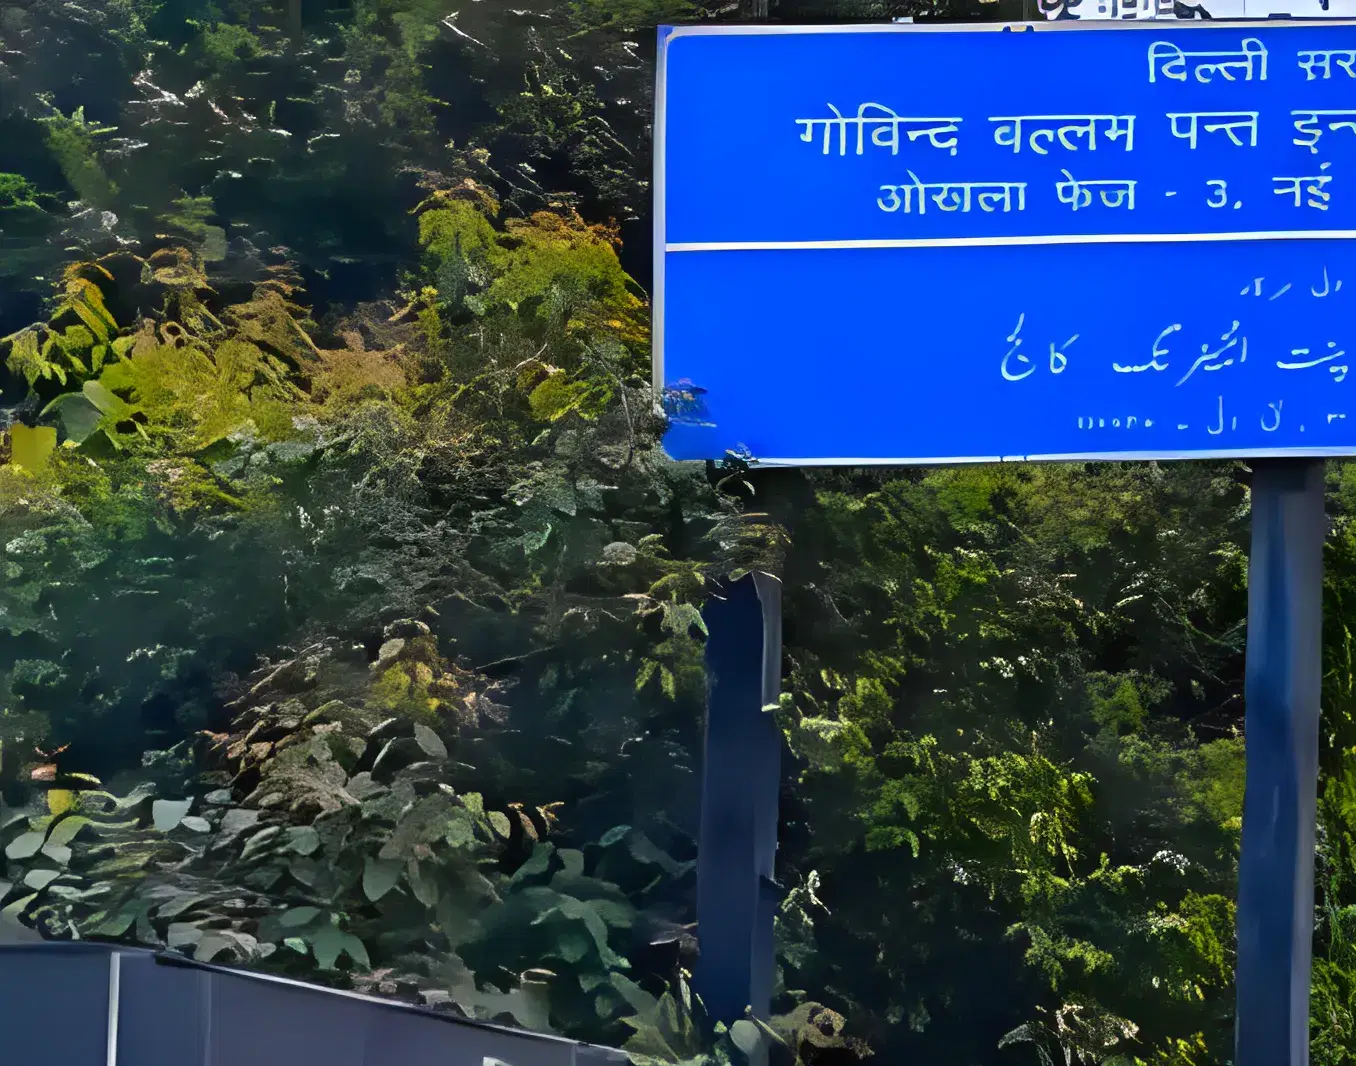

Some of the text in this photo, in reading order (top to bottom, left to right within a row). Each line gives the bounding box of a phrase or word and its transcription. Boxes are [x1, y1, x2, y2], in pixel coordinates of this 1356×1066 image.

[794, 102, 963, 156] गोविन्द
[1165, 111, 1260, 150] पन्त
[876, 169, 1028, 215] ओखला
[1055, 167, 1138, 212] फेज
